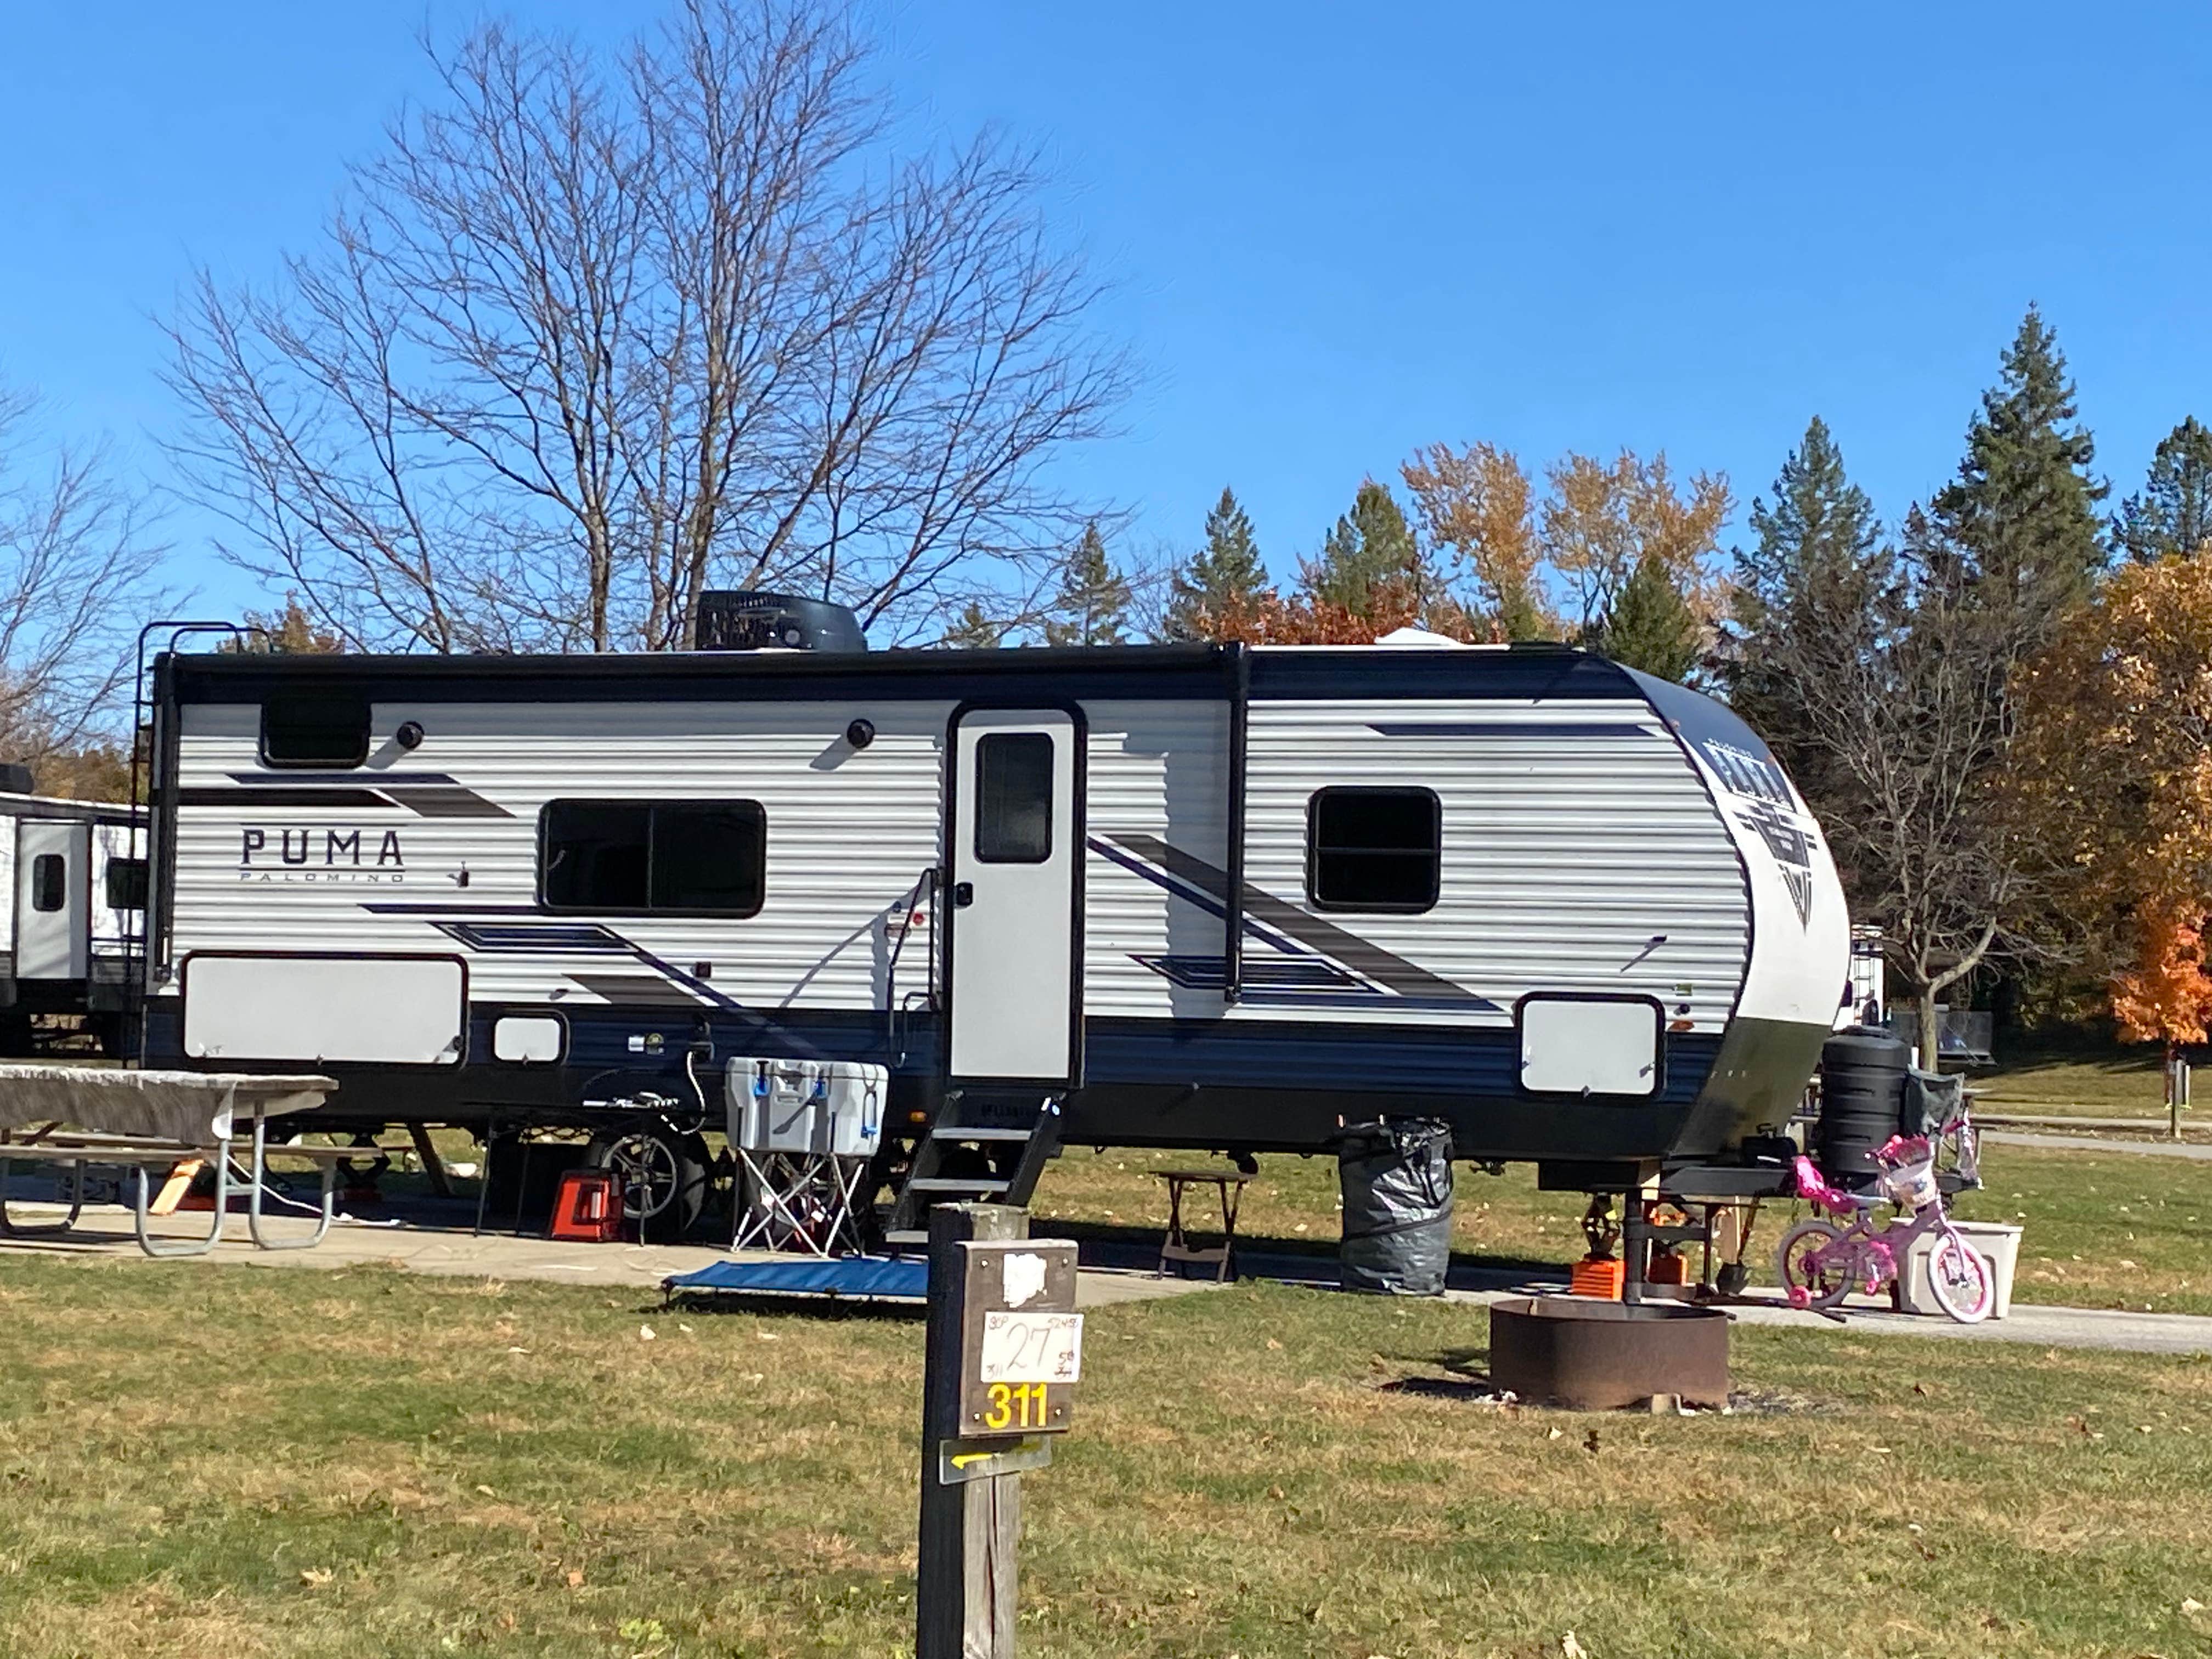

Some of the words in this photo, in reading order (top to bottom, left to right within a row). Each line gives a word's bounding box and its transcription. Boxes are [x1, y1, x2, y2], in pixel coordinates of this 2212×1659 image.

[240, 829, 404, 866] PUMA
[240, 873, 403, 883] PALOMINO
[1007, 1322, 1051, 1371] 27
[985, 1382, 1047, 1429] 311
